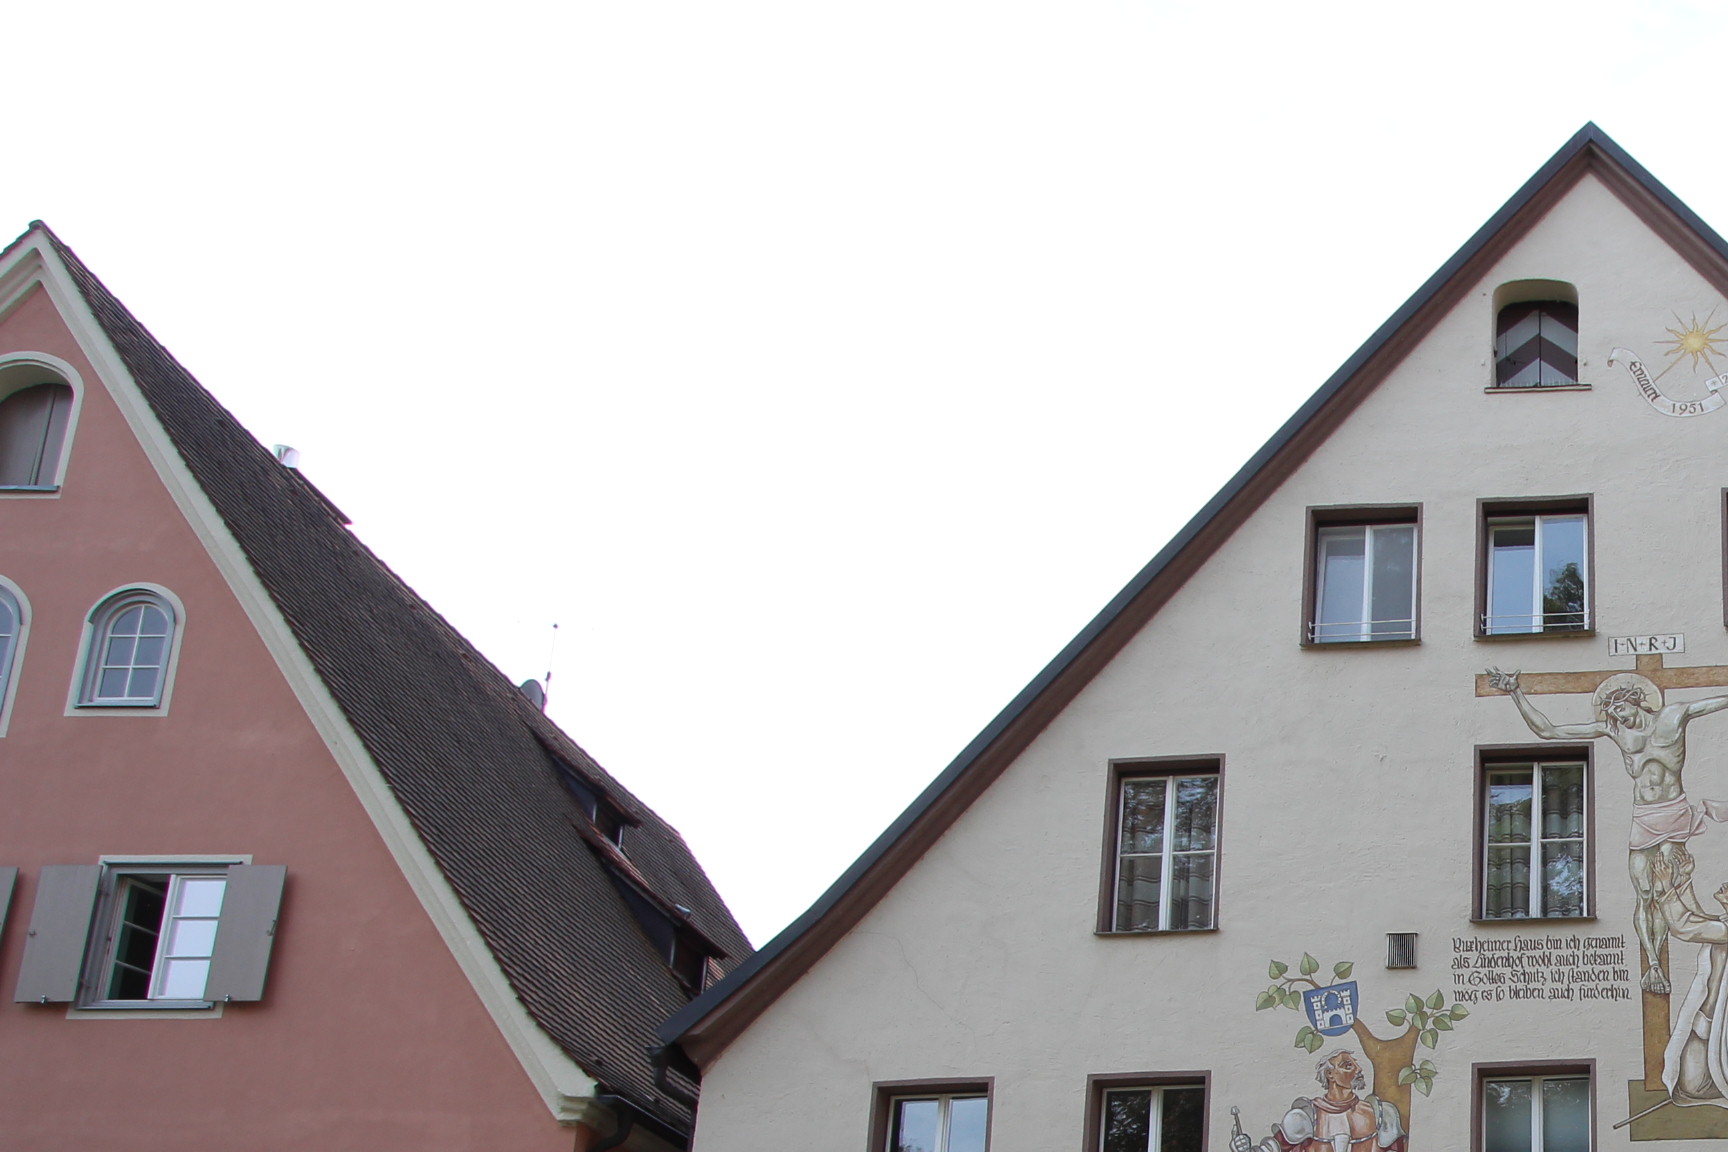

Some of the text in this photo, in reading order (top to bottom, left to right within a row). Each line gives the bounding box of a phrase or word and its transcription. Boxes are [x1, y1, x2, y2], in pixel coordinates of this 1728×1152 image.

[1670, 401, 1705, 416] 1951
[1513, 935, 1544, 952] Haus
[1546, 935, 1562, 950] bin
[1565, 934, 1580, 951] ich
[1451, 954, 1471, 969] als
[1472, 952, 1526, 970] Lindenhof
[1527, 952, 1552, 968] wohl
[1554, 952, 1579, 968] auch
[1453, 971, 1465, 985] in
[1468, 970, 1506, 986] Gottes
[1550, 969, 1565, 984] ich
[1481, 989, 1495, 1001] es
[1508, 985, 1546, 1000] bleiben
[1548, 985, 1574, 1001] auch
